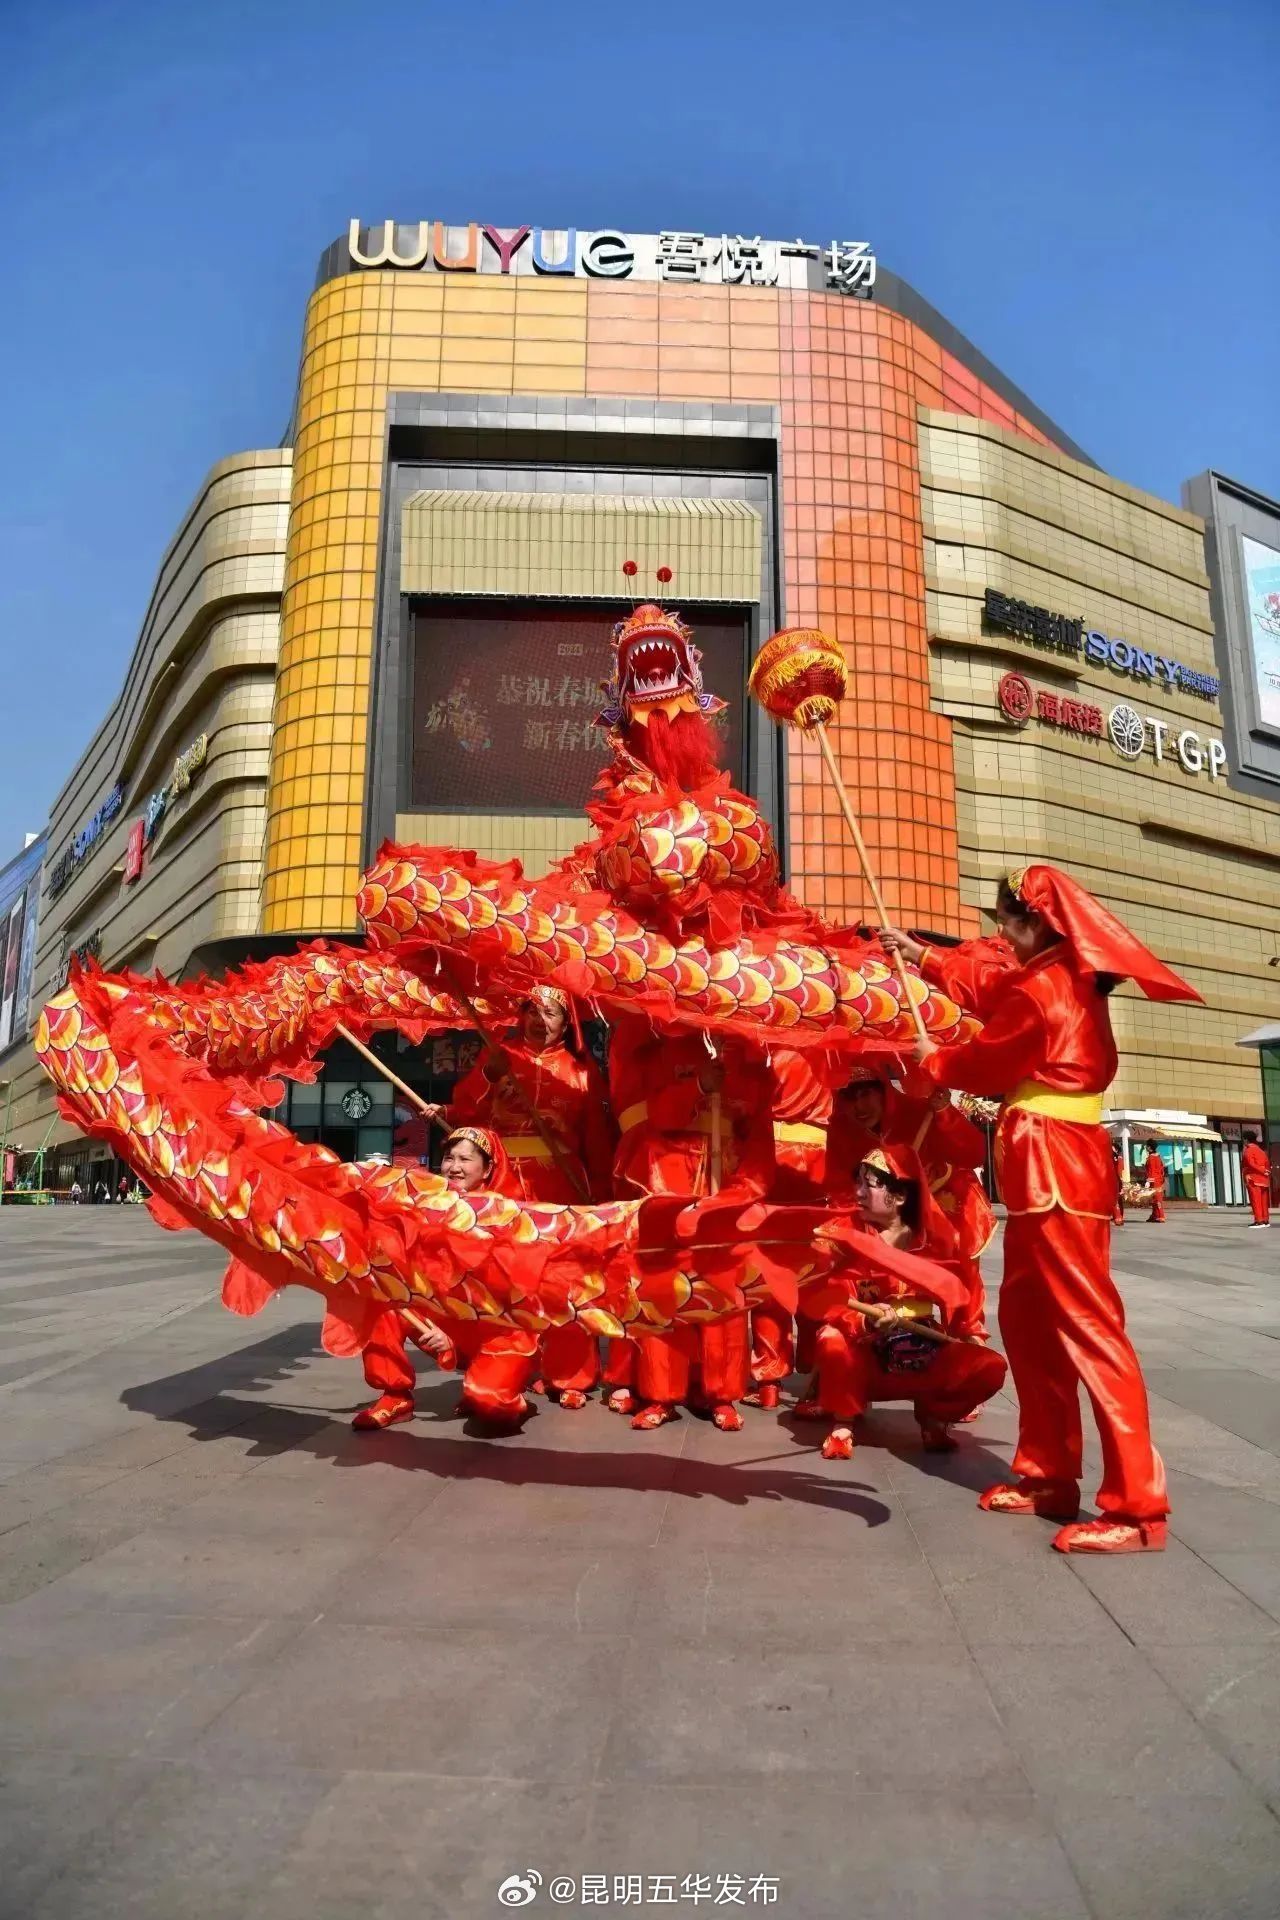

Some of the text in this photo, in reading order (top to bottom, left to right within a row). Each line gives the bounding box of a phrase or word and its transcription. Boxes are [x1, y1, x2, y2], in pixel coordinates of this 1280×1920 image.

[656, 231, 876, 287] 吾悦广场
[1087, 630, 1181, 684] SONY
